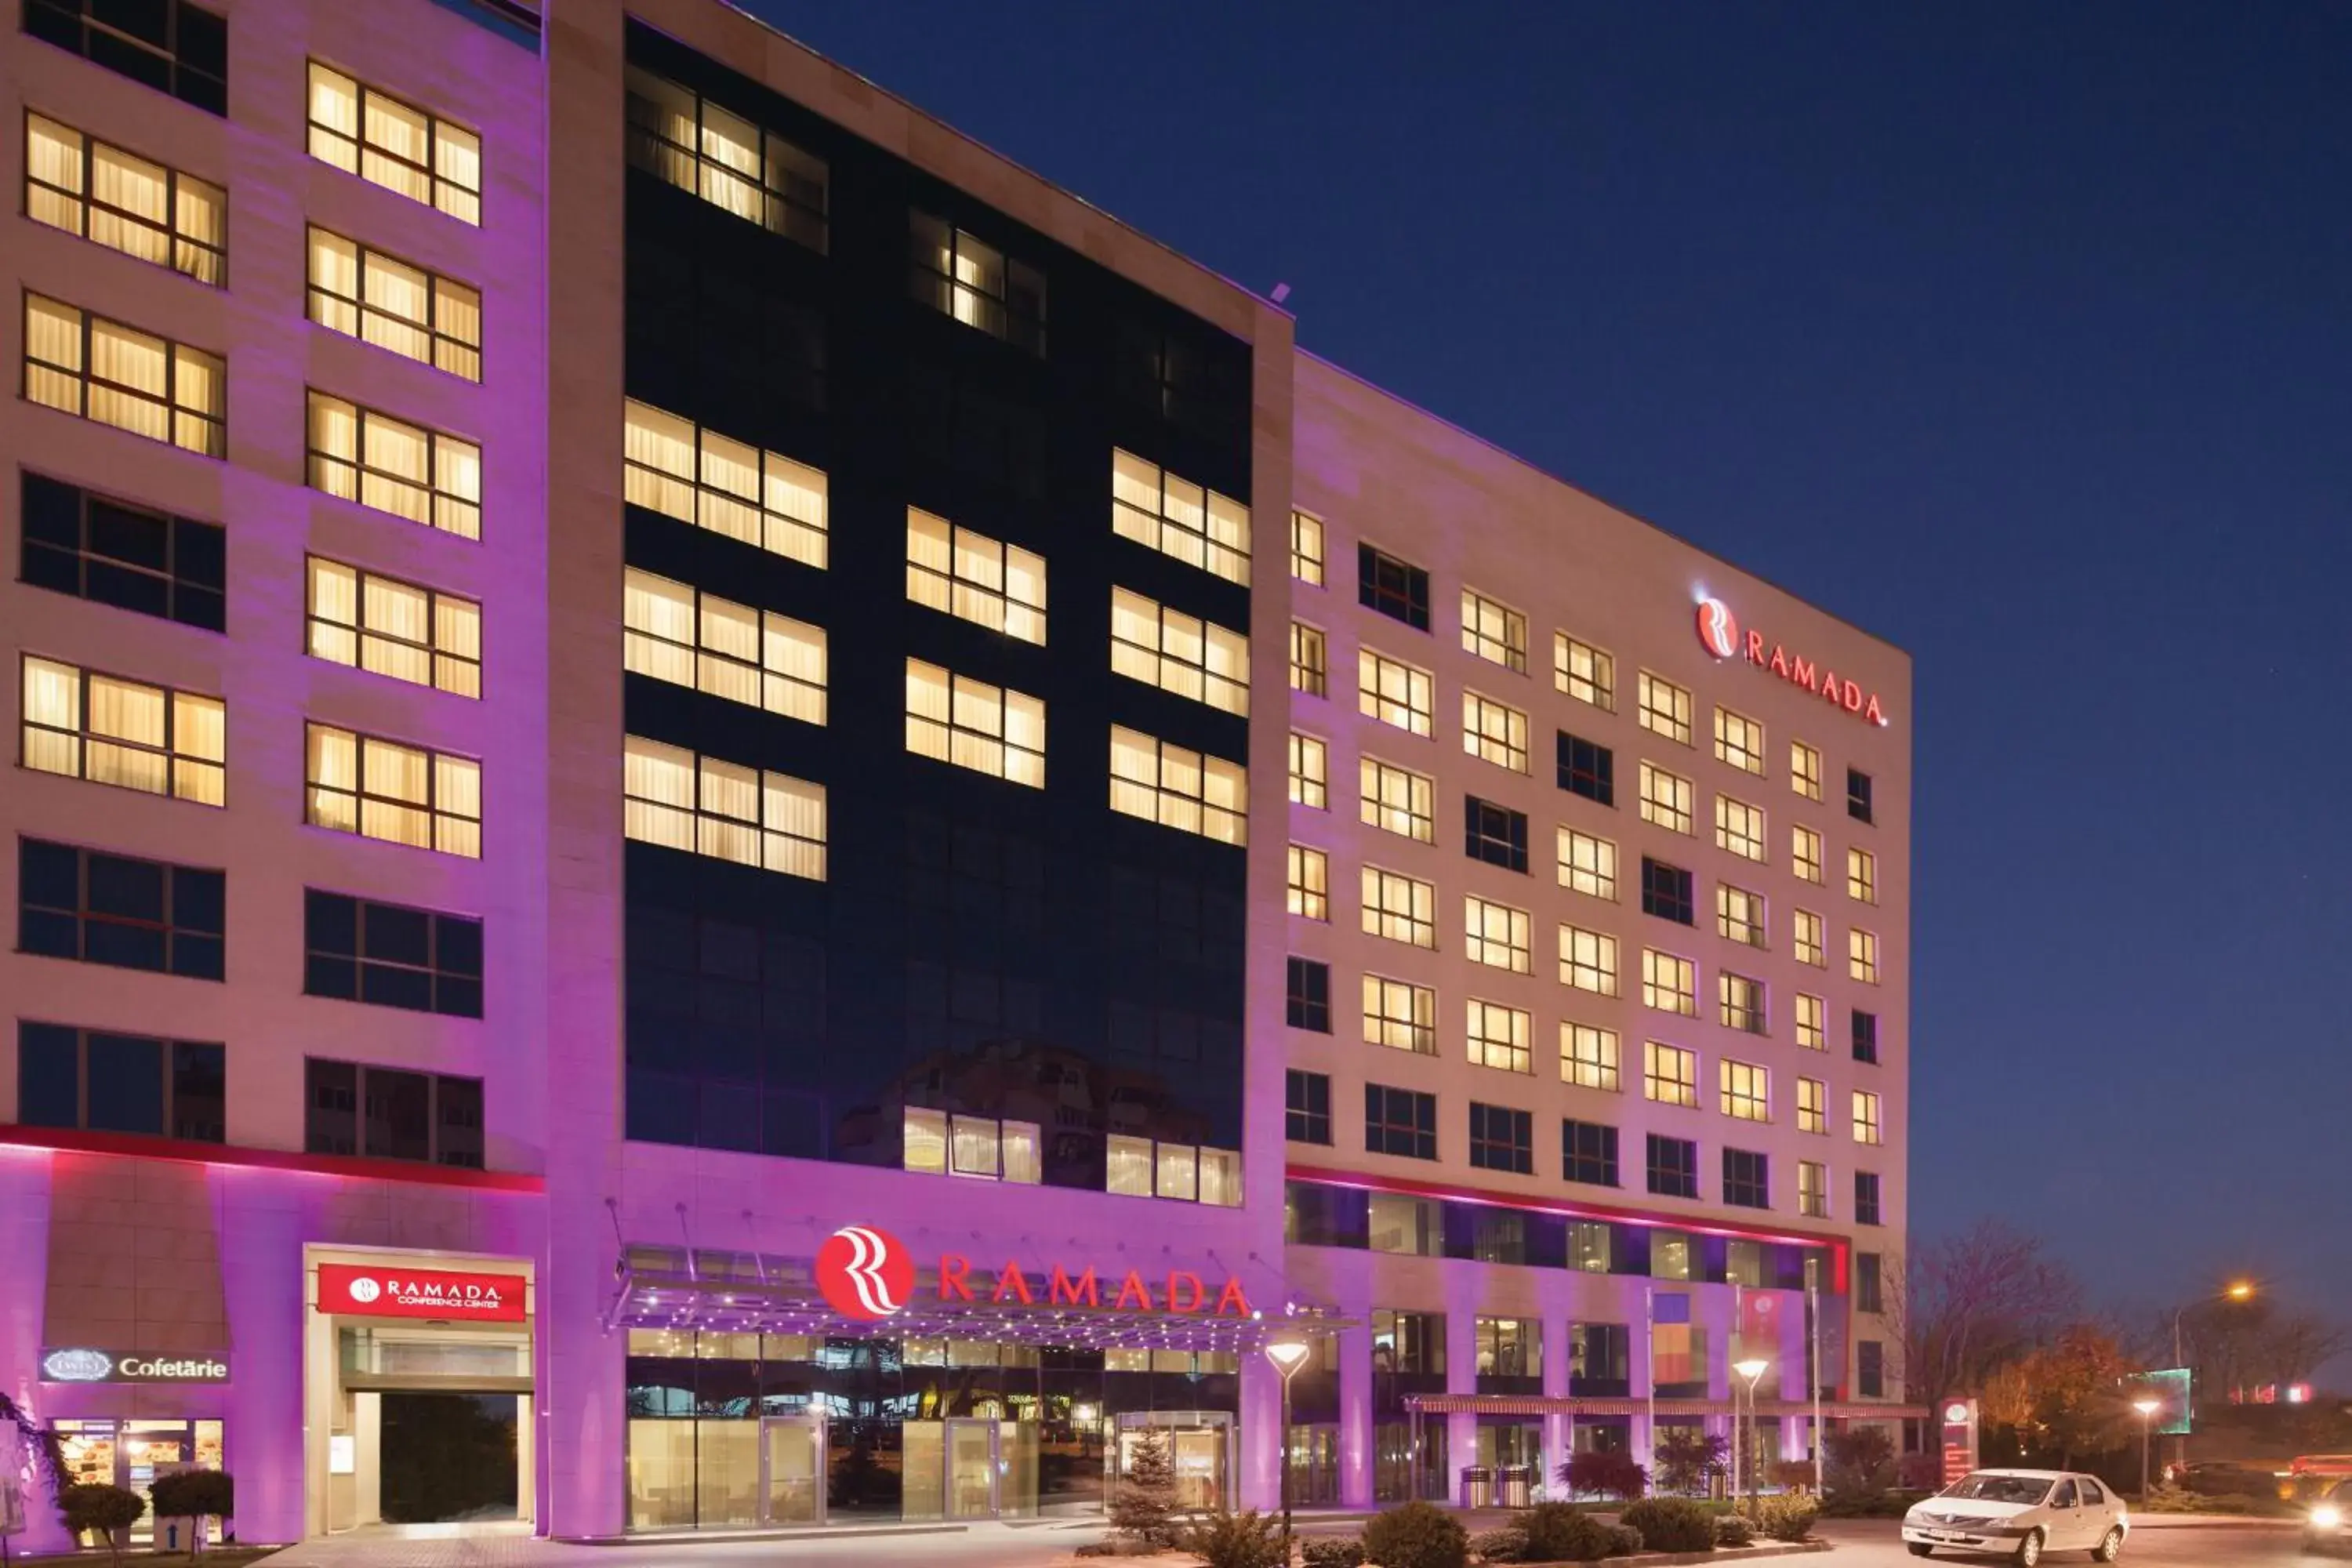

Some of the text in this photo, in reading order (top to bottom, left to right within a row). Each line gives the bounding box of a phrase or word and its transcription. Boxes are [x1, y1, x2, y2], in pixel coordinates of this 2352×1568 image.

[1745, 630, 1882, 723] RAMADA
[388, 1280, 499, 1299] RAMADA
[940, 1254, 1253, 1317] RAMADA
[397, 1296, 499, 1308] CONFERENCE CENTER
[119, 1358, 227, 1377] Cofetărie
